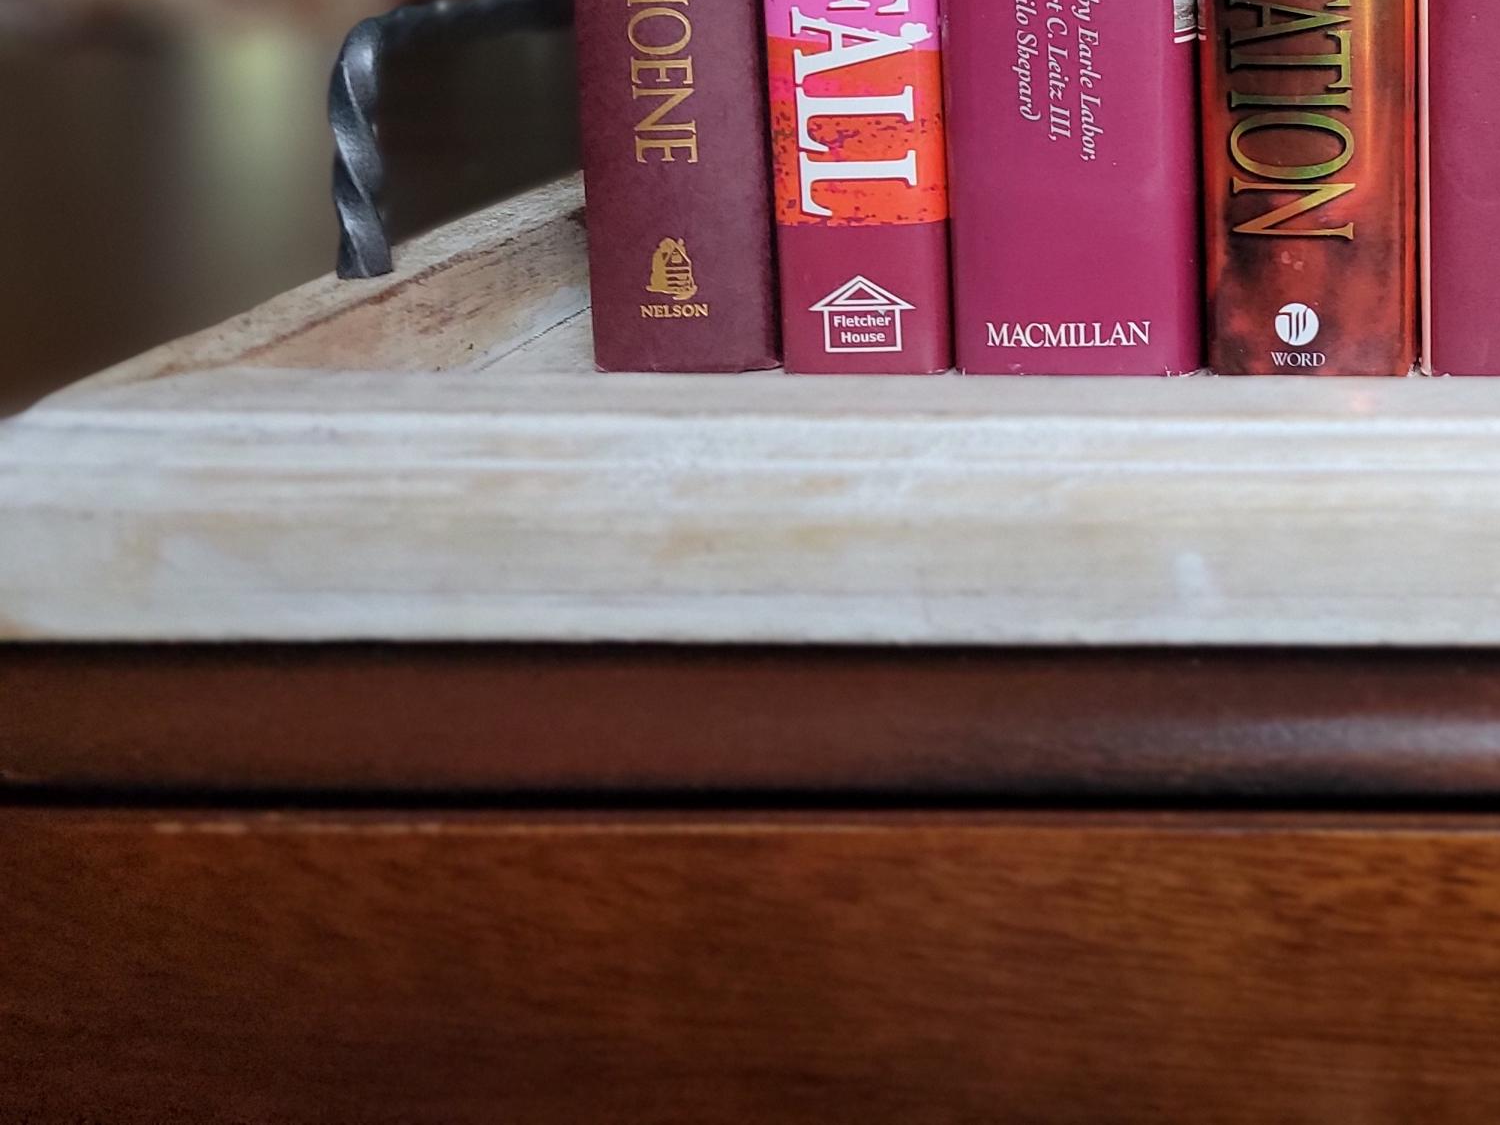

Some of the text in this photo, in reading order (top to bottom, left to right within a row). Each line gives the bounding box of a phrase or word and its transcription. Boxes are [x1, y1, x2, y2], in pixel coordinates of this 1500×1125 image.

[1046, 17, 1068, 39] C.
[1078, 24, 1101, 89] Earle
[1012, 30, 1041, 122] Shepard
[1048, 43, 1069, 101] Leitz
[1048, 104, 1071, 142] III,
[1080, 92, 1103, 162] Labor,
[640, 303, 709, 319] NELSON
[833, 315, 892, 329] Fletcher
[841, 330, 886, 345] House
[986, 320, 1150, 349] MACMILLAN
[1270, 351, 1326, 367] WORD
